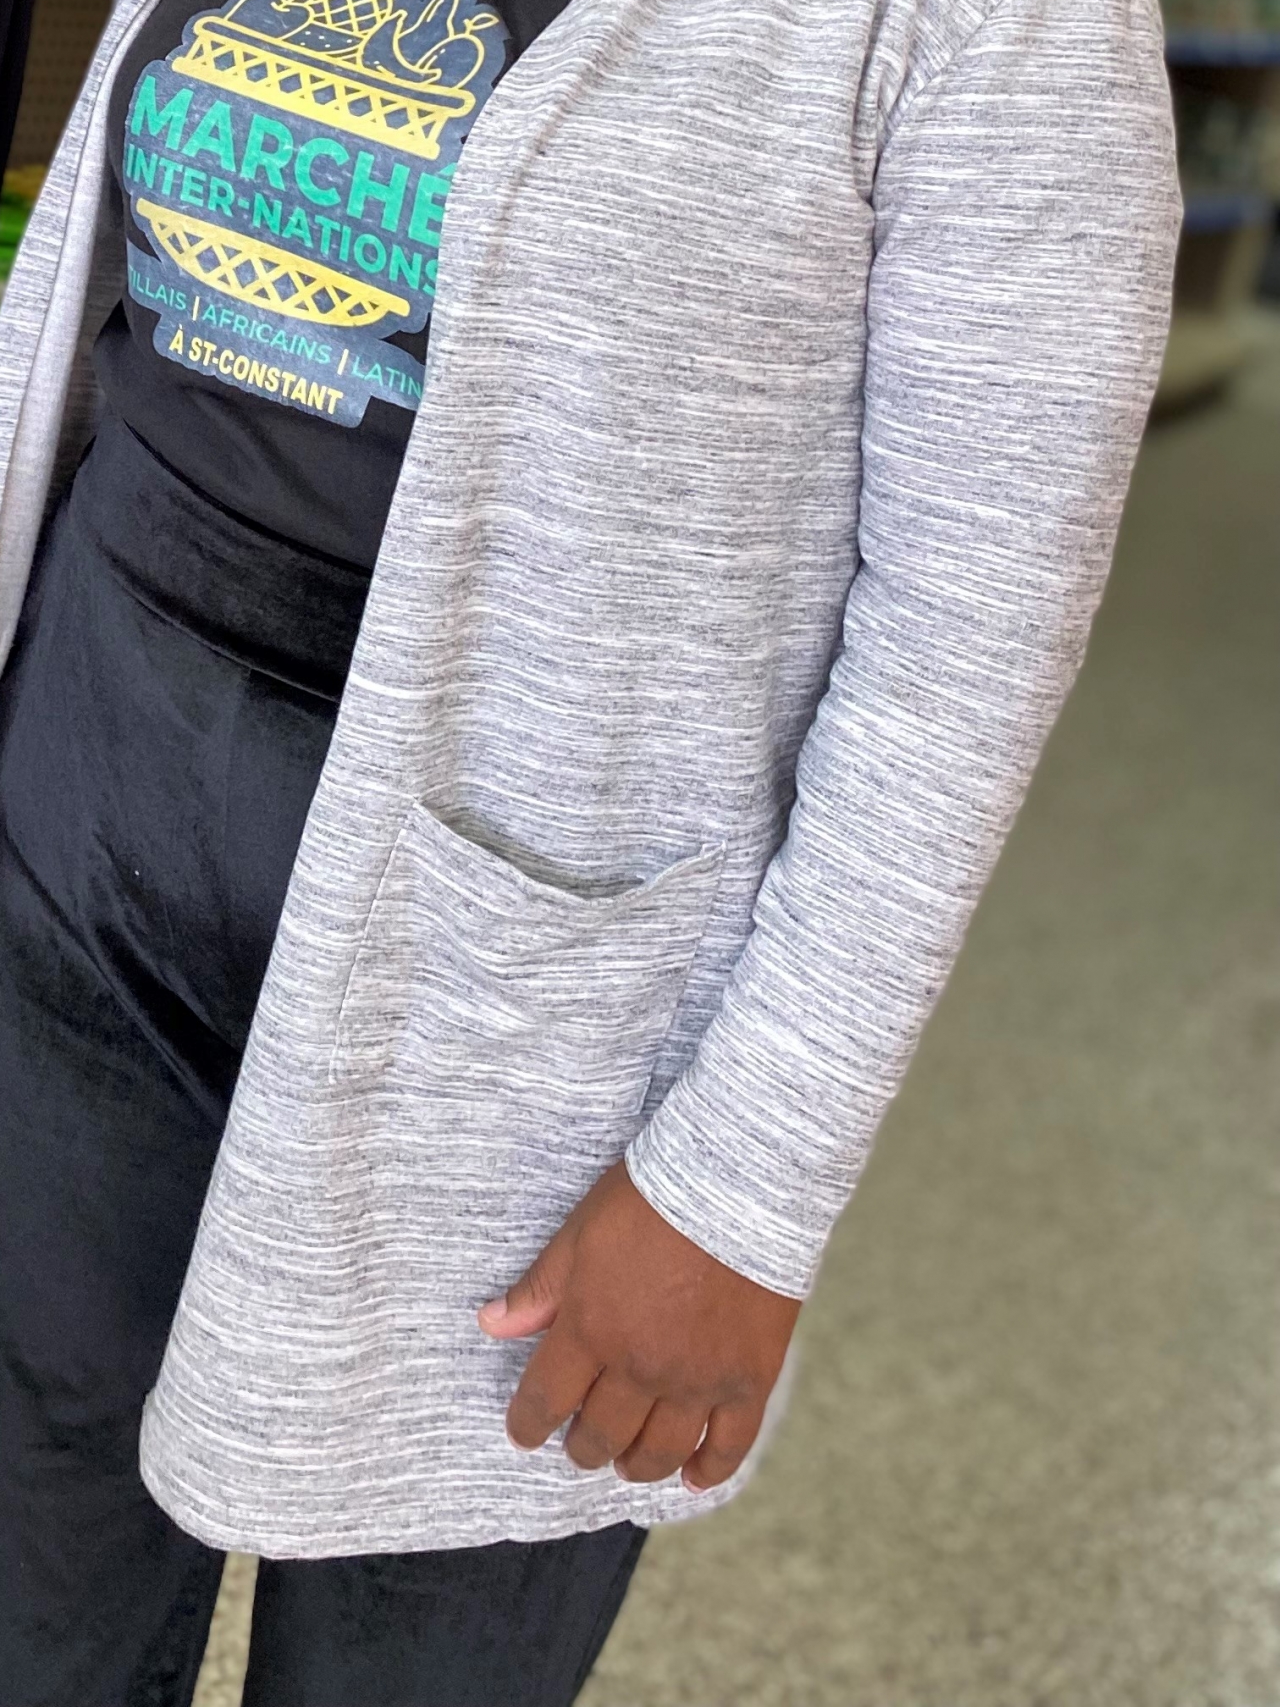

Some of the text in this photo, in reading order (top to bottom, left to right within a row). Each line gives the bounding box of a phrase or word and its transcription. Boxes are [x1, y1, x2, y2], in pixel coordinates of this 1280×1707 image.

[131, 76, 457, 248] MARCHÉ
[169, 323, 344, 415] À ST-CONSTANT
[202, 304, 333, 364] AFRICAINS
